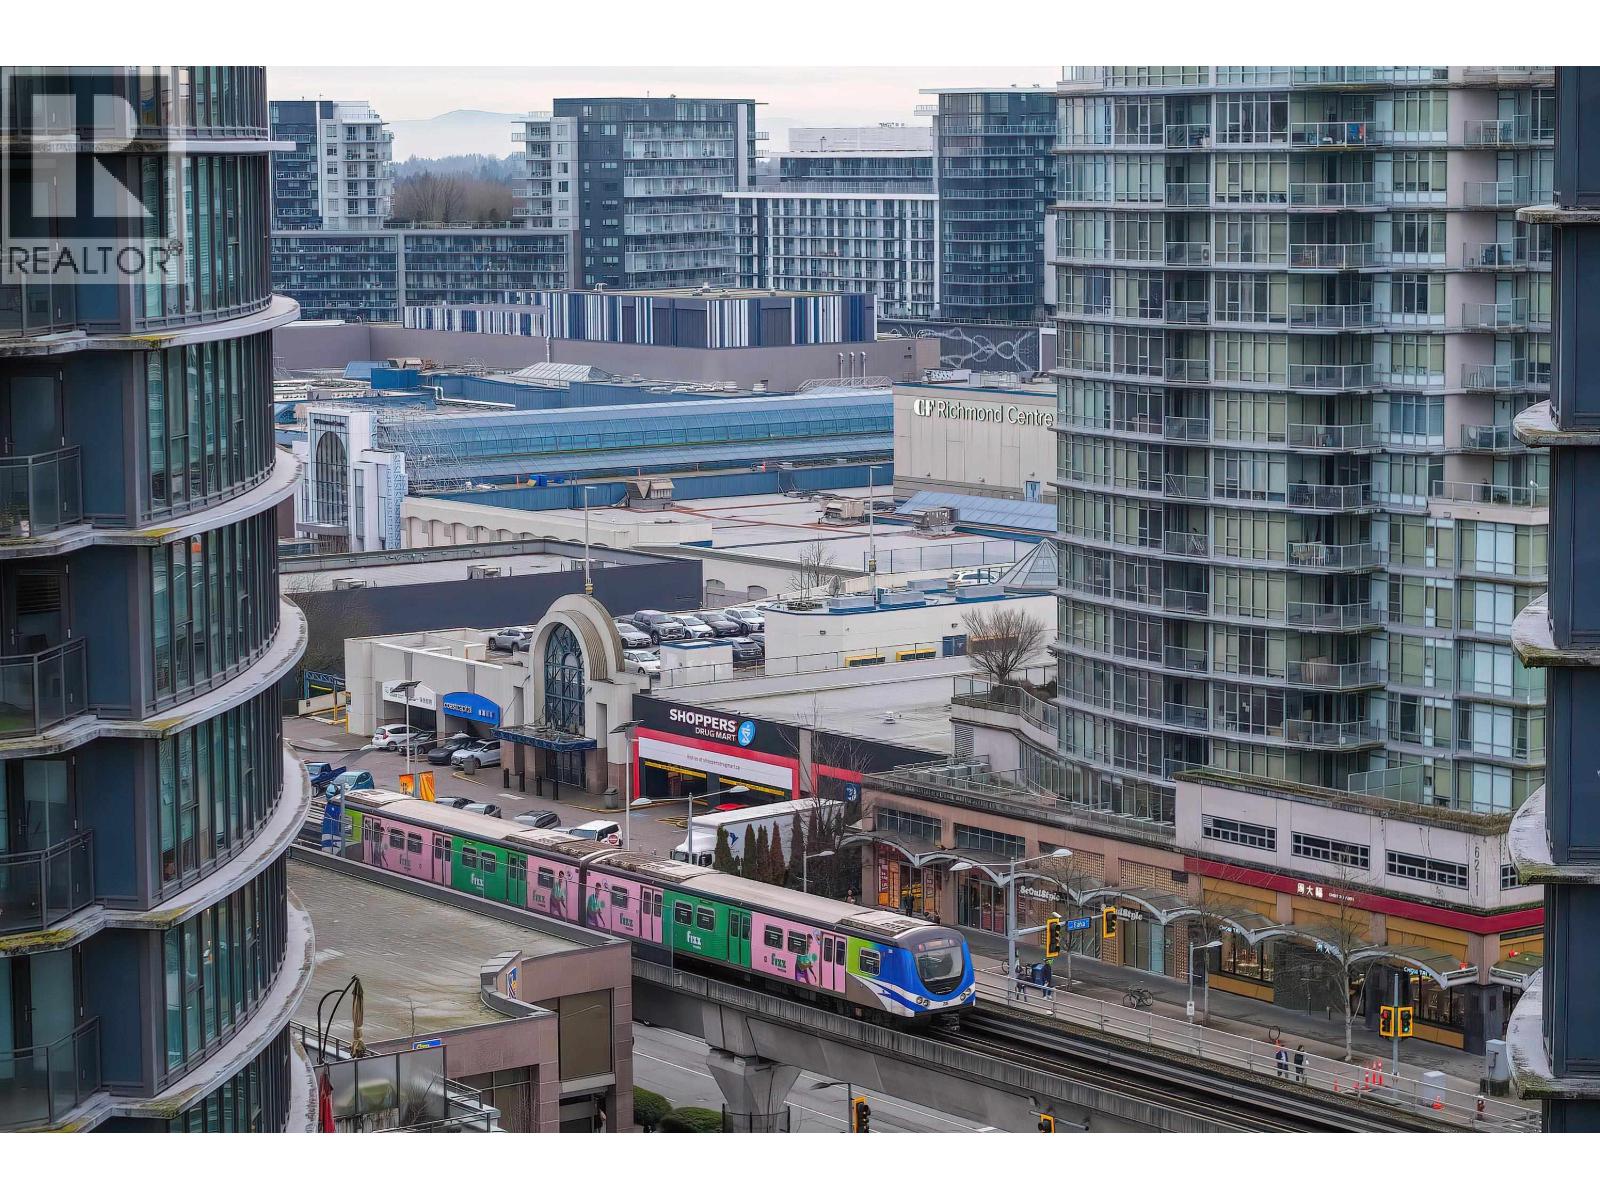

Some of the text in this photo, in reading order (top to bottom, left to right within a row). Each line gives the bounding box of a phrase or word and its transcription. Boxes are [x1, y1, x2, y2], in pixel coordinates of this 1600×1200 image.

[938, 400, 1003, 424] Richmond
[1007, 405, 1054, 427] Centre
[669, 708, 737, 733] SHOPPERS
[695, 726, 738, 742] DRUG MART
